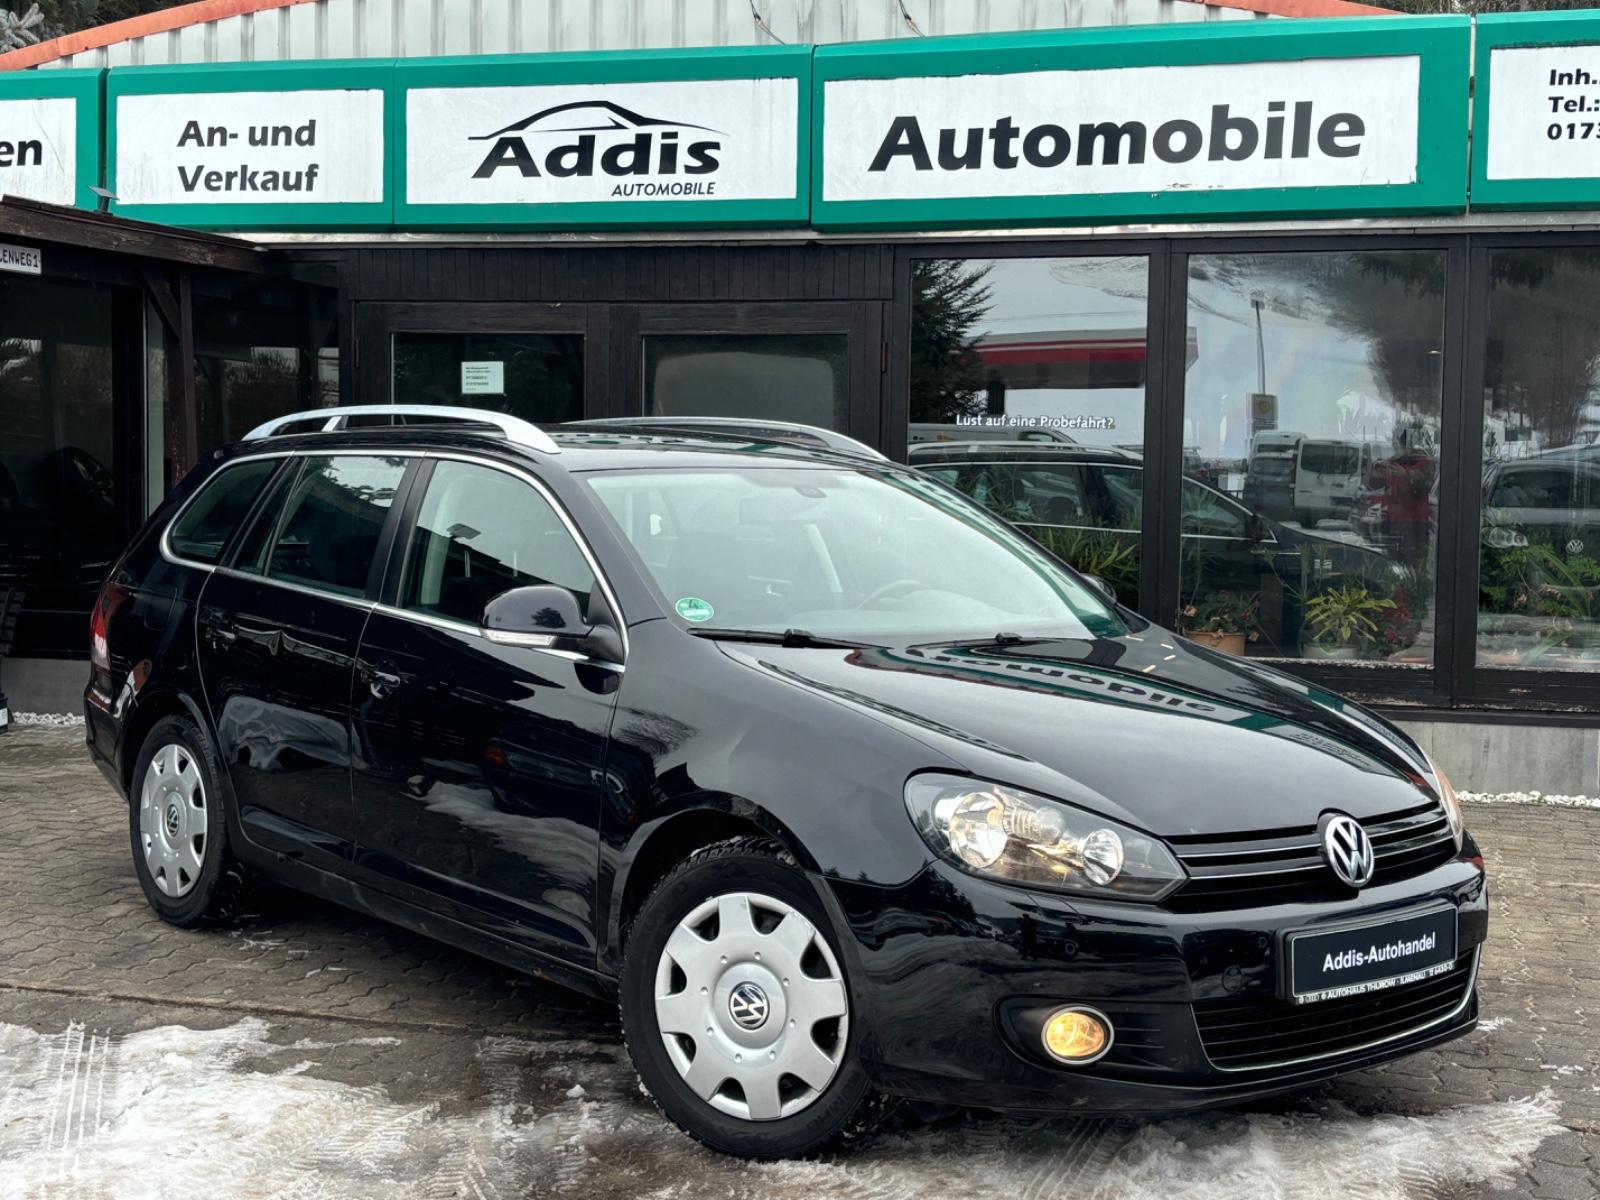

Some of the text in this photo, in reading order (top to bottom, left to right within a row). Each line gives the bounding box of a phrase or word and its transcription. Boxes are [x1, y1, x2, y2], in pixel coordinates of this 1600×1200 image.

[1548, 95, 1600, 113] Tel.:
[177, 119, 316, 147] An- und
[868, 101, 1365, 172] Automobile
[471, 131, 721, 178] Addis
[177, 163, 319, 192] Verkauf
[611, 182, 716, 197] AUTOMOBILE
[956, 414, 1115, 429] Lust auf eine Probefahrt?
[1322, 931, 1436, 972] Addis-Autohandel
